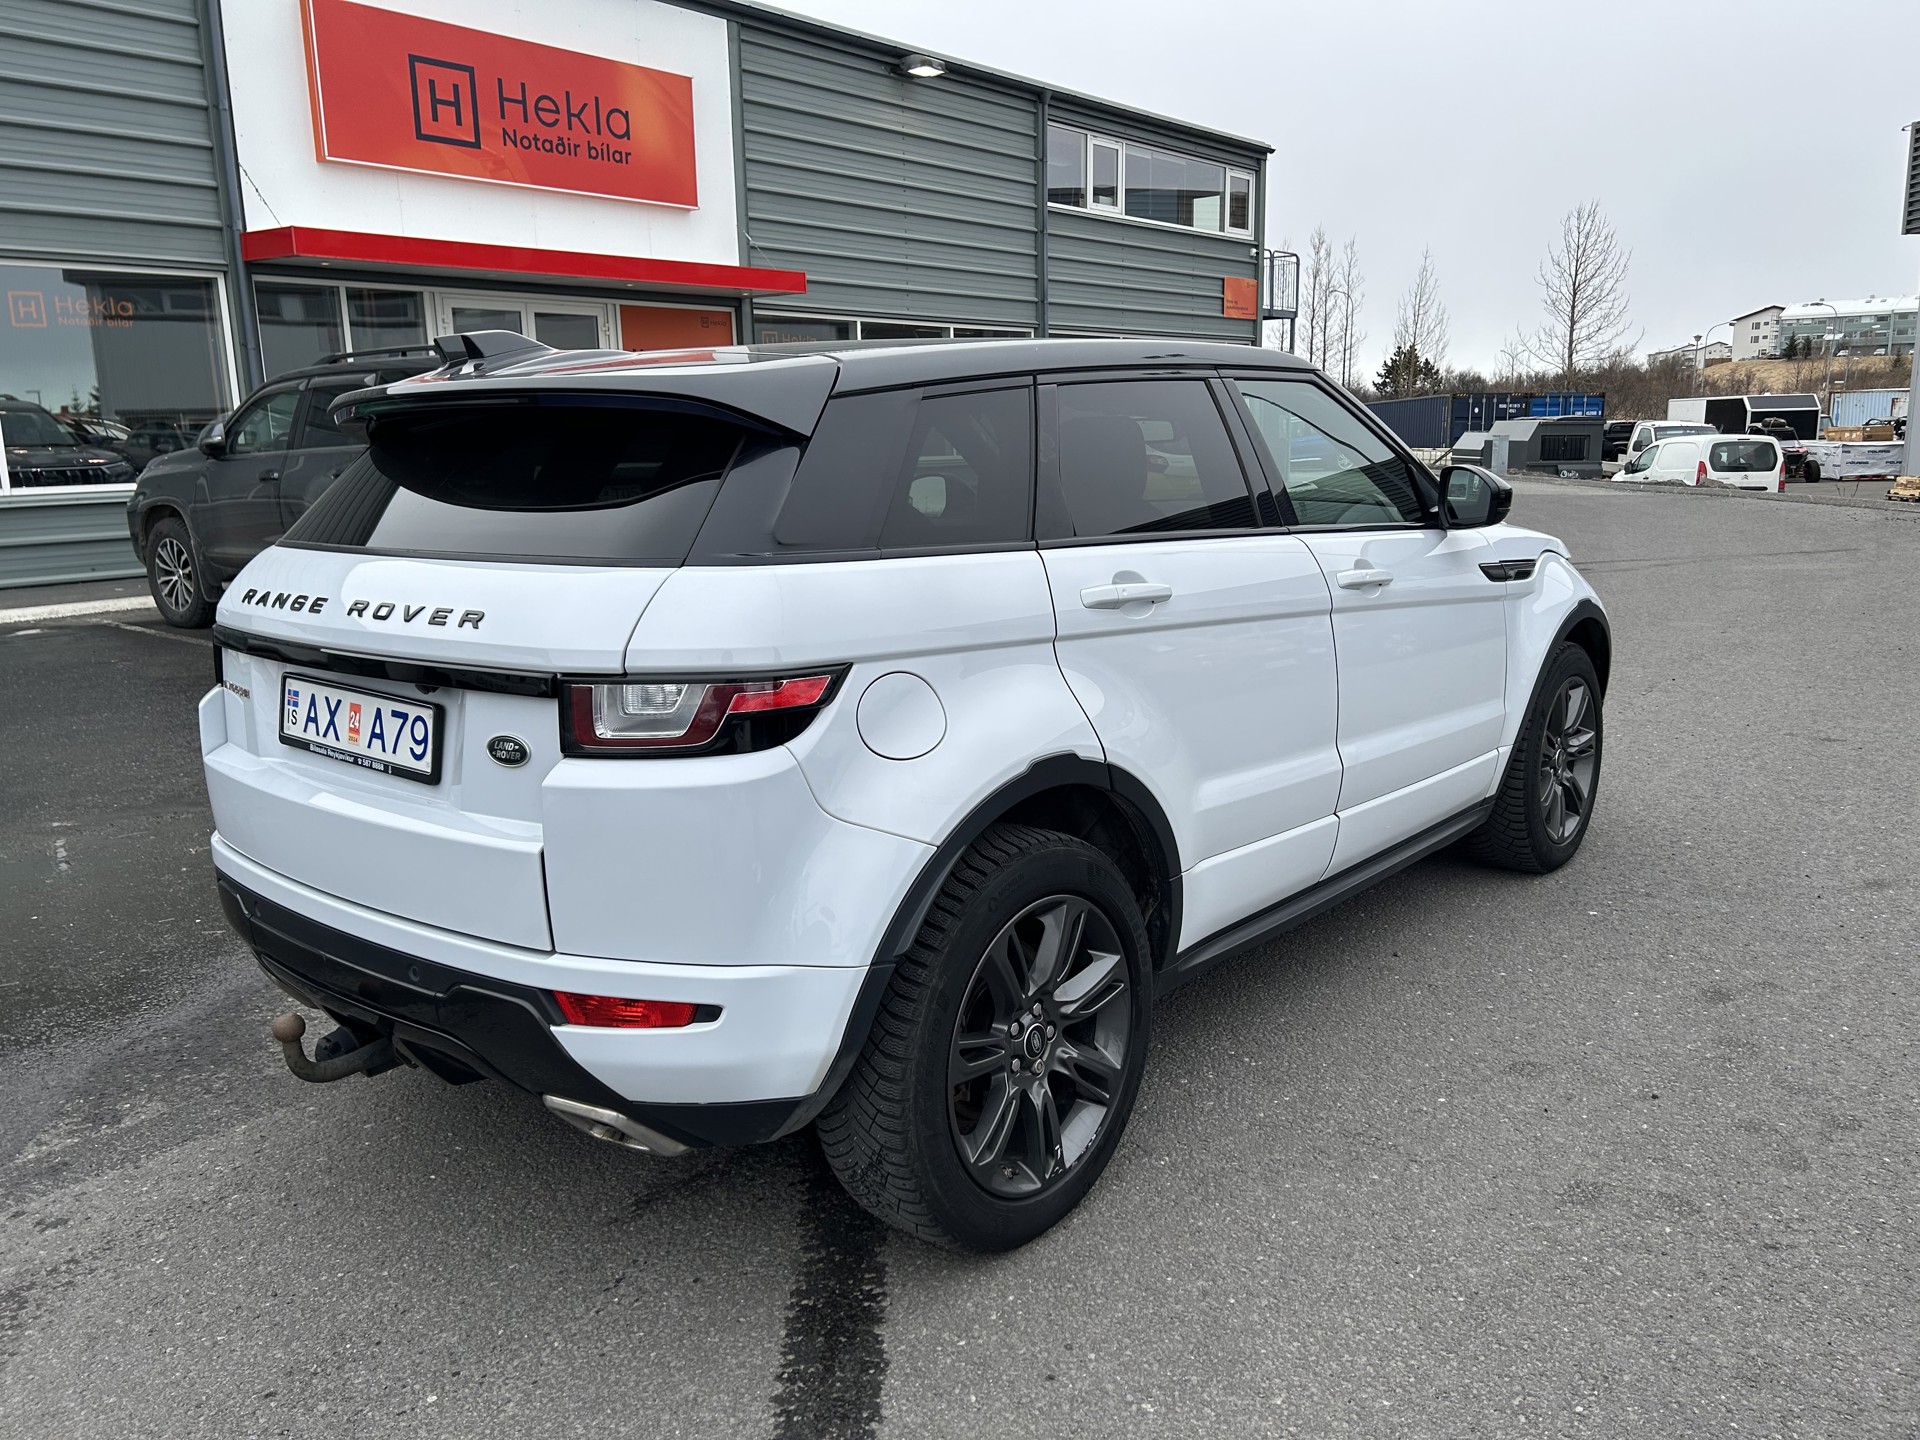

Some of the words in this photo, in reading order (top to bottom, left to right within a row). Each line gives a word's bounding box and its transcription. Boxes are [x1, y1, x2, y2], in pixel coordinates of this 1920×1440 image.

[497, 77, 631, 141] Hekla
[502, 126, 581, 158] Notaðir
[587, 141, 632, 165] bílar
[55, 295, 134, 317] Hekla
[241, 588, 329, 615] RANGE
[346, 599, 485, 630] ROVER
[287, 707, 298, 725] IS
[303, 692, 342, 742] AX
[367, 707, 429, 762] A79
[349, 711, 360, 730] 24
[494, 741, 515, 751] LAND
[496, 750, 521, 760] ROVER
